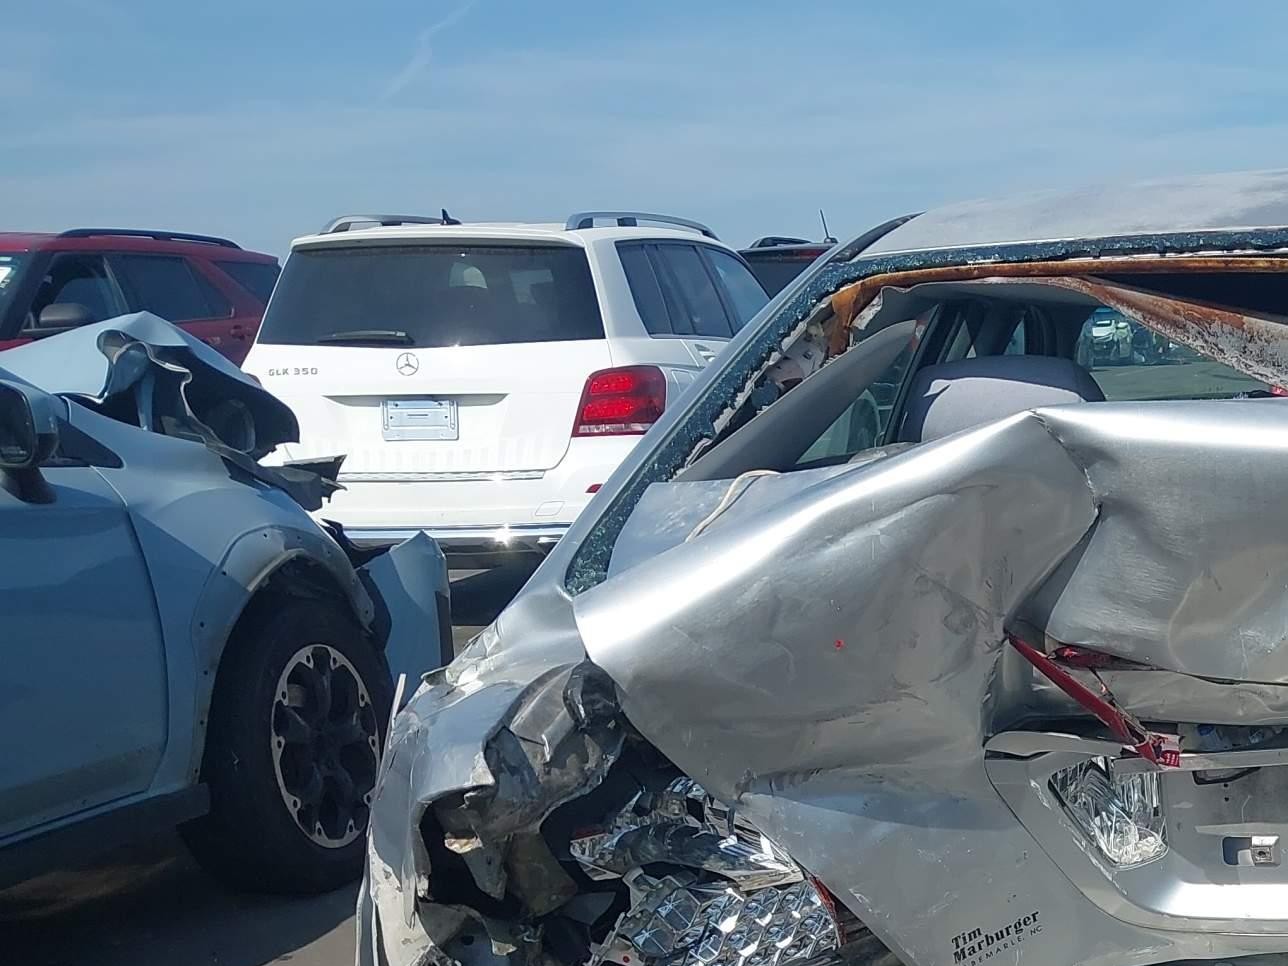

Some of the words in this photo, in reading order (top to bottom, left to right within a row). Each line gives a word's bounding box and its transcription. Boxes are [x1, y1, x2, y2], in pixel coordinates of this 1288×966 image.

[268, 367, 289, 377] GLK
[293, 367, 319, 376] 350
[951, 927, 983, 950] Tim
[952, 910, 1040, 964] Marburger
[1030, 924, 1043, 937] NC
